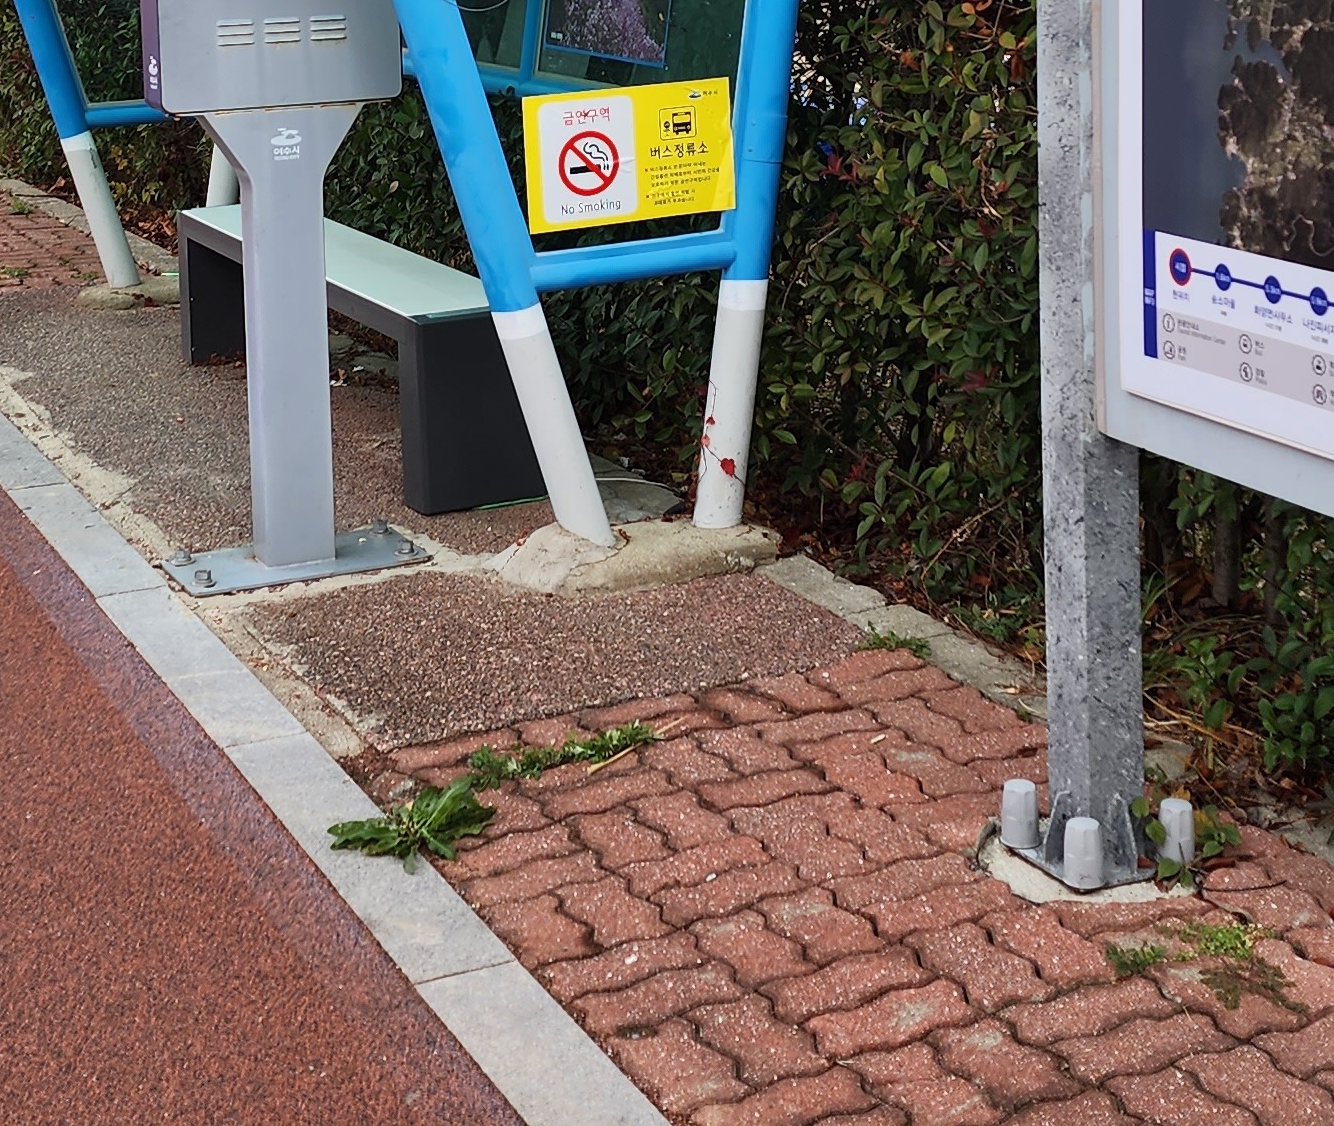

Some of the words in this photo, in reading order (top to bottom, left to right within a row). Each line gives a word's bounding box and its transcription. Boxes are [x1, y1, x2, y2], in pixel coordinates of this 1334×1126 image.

[273, 145, 300, 156] 여수시
[650, 141, 709, 161] 버스정류소
[561, 204, 575, 216] No
[578, 199, 622, 215] Smoking
